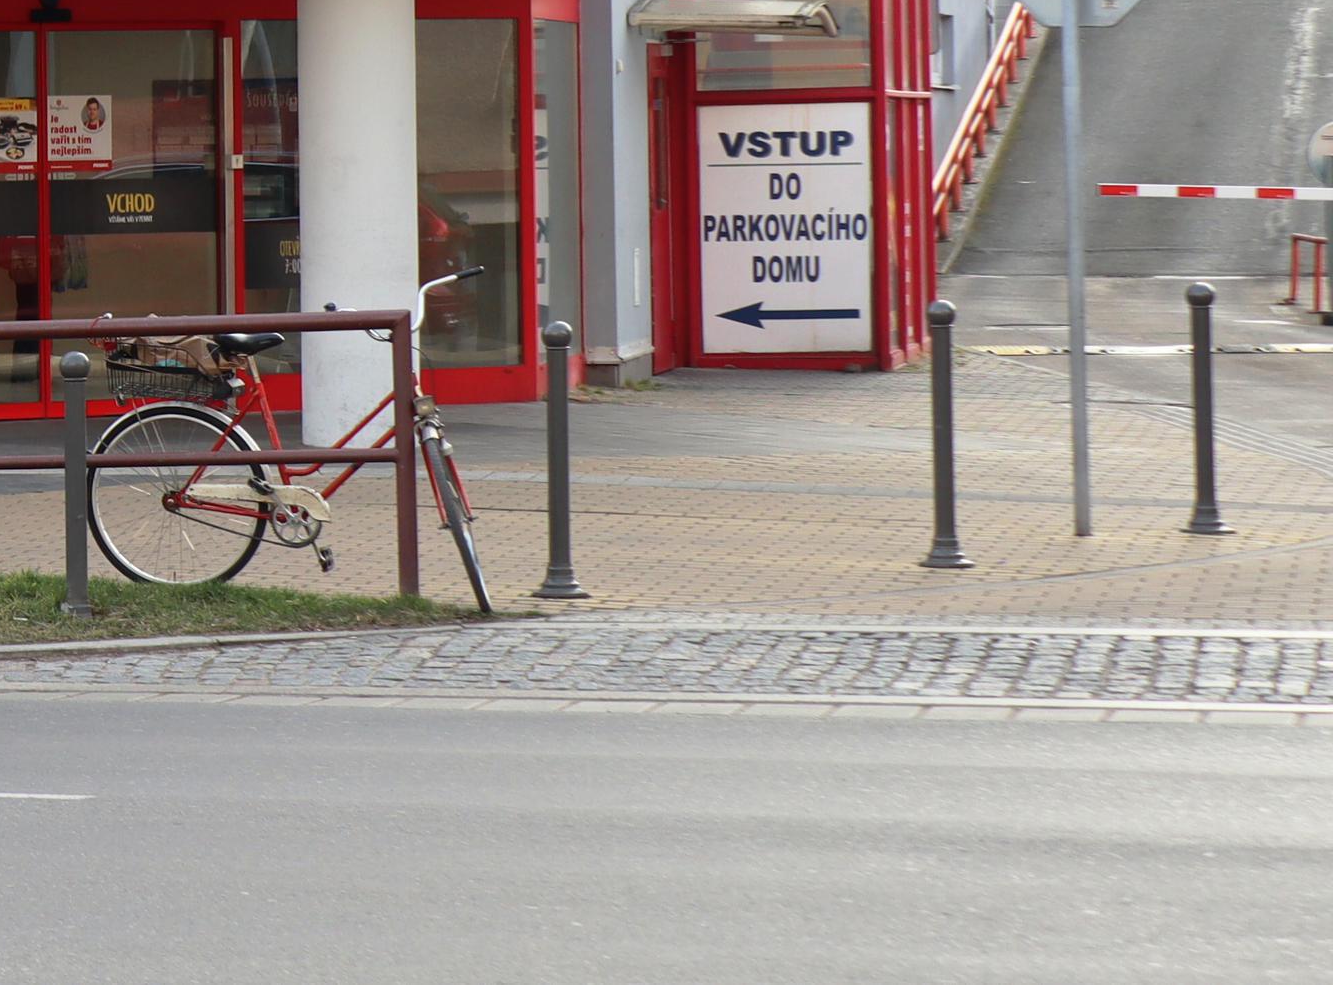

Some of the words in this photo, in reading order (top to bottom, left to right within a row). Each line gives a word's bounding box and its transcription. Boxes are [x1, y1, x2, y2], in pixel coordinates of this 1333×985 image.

[51, 125, 77, 133] radost
[51, 135, 70, 144] vařit
[78, 135, 92, 144] tím
[718, 131, 854, 158] VSTUP
[770, 173, 801, 200] DO
[106, 193, 155, 213] VCHOD
[704, 207, 868, 242] PARKOVACÍHO
[753, 256, 819, 283] DOMU
